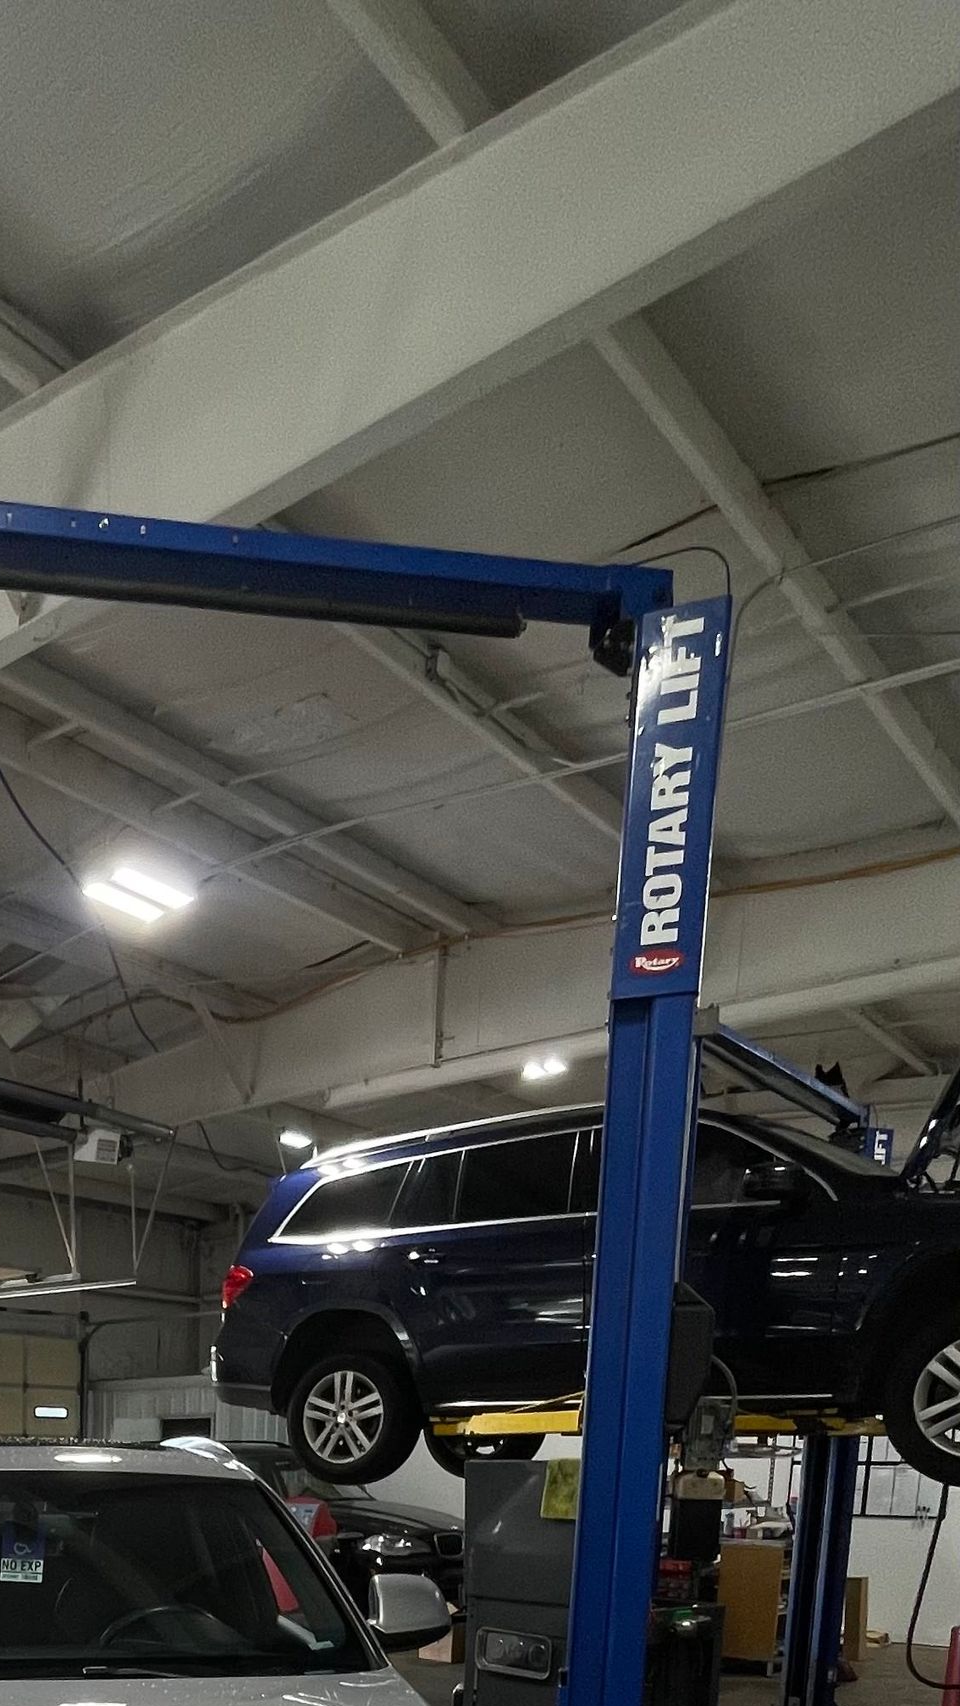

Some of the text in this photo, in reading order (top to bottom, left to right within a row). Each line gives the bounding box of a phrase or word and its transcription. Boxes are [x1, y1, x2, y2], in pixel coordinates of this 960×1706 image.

[640, 615, 704, 945] ROTARY LIFT
[635, 956, 679, 971] Rotary
[1, 1559, 41, 1572] NO EXP
